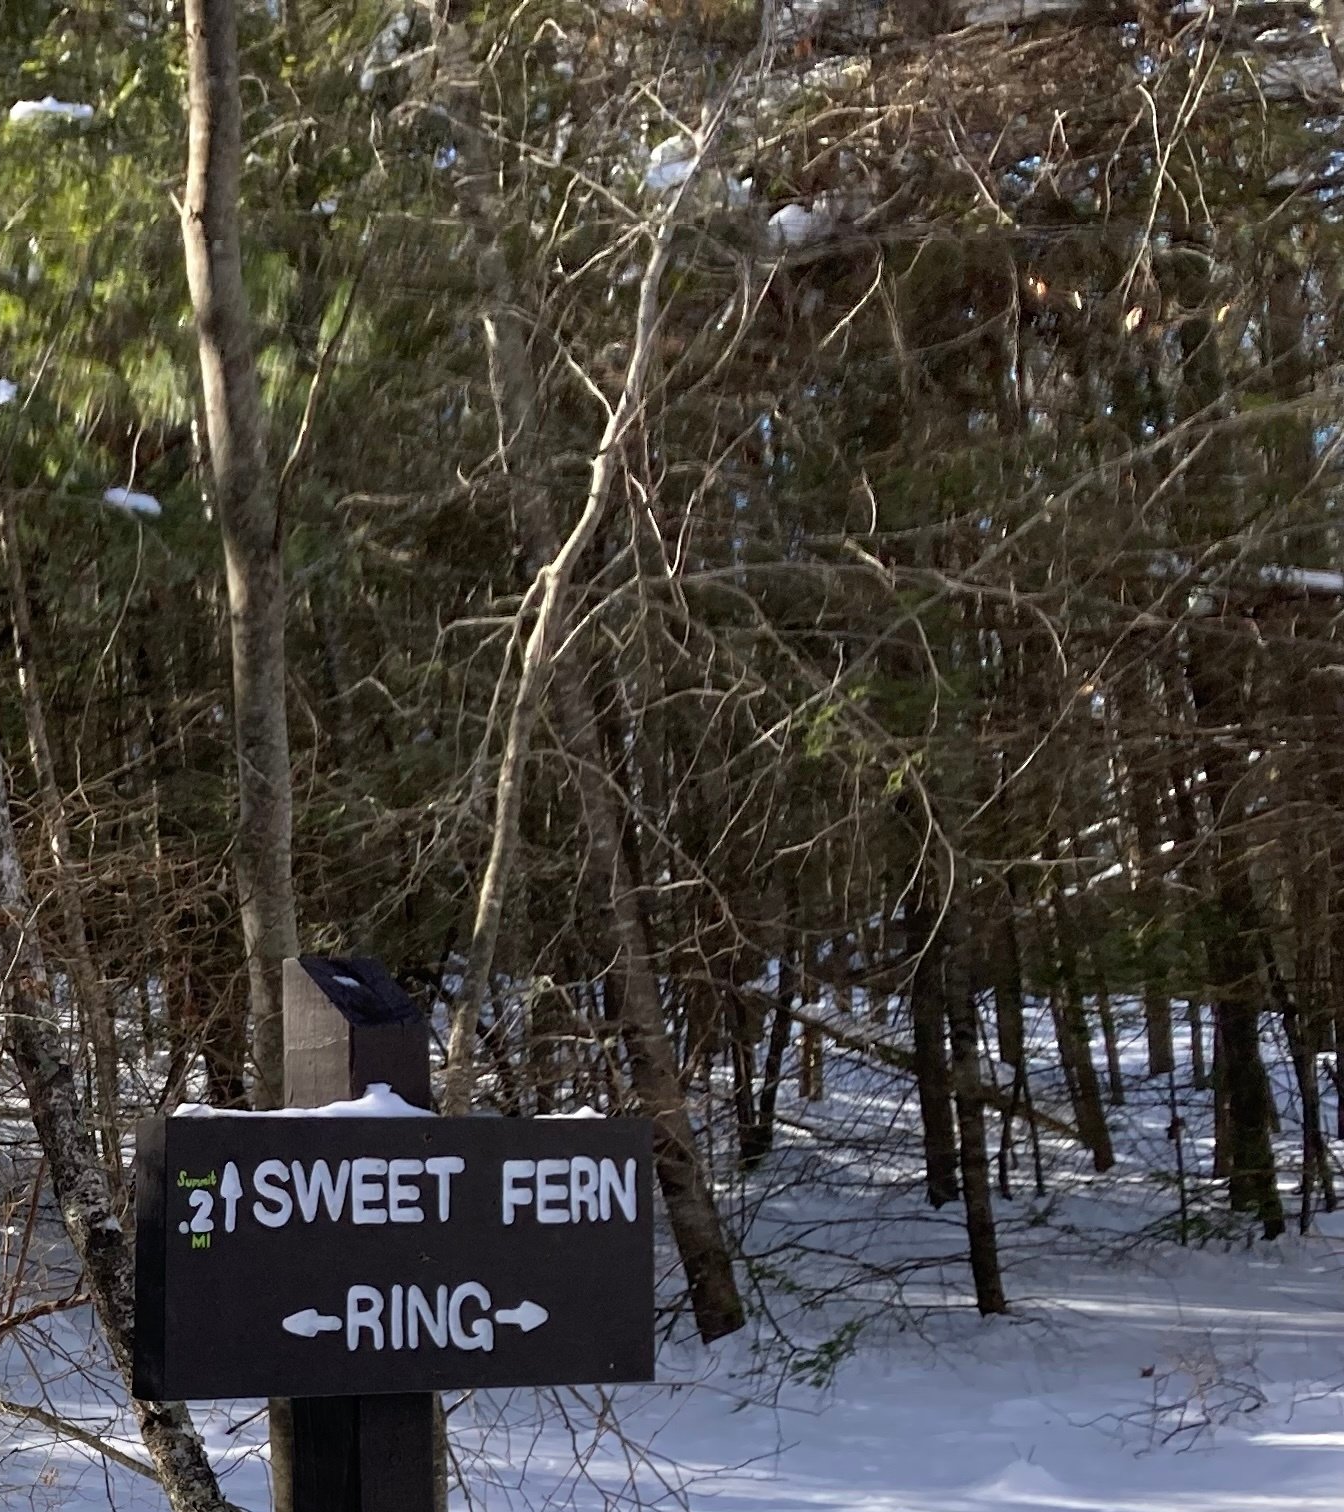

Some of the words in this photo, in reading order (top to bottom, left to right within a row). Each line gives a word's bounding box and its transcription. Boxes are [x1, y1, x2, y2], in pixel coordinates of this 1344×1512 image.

[178, 1189, 215, 1234] .2
[252, 1156, 465, 1229] SWEET
[502, 1155, 638, 1226] FERN
[346, 1281, 495, 1352] RING
